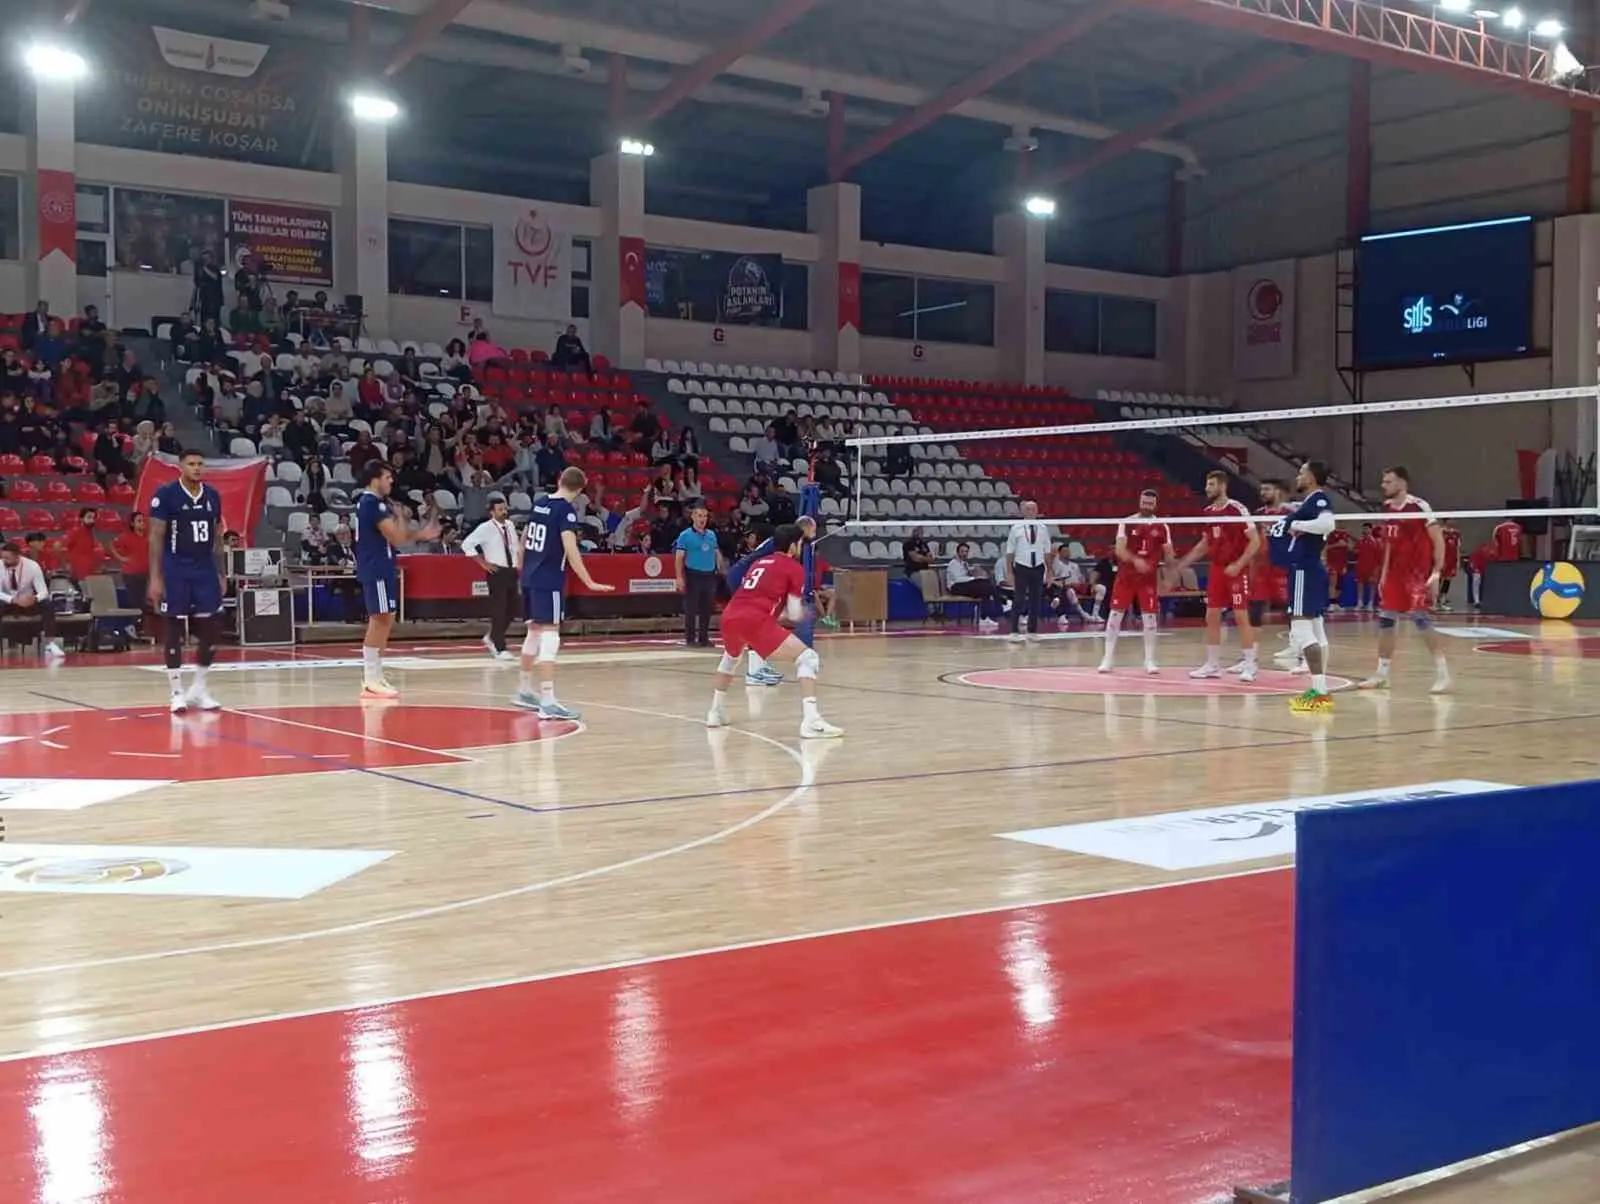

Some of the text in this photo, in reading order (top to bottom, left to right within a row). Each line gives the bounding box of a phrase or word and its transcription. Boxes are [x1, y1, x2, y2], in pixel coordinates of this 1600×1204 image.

[200, 84, 297, 113] COŞARSA
[137, 96, 266, 129] ONİKİŞUBAT
[119, 116, 281, 153] ZAFERE KOŞAR
[508, 261, 558, 288] TVF
[713, 327, 725, 342] G
[913, 344, 923, 358] G
[190, 520, 210, 543] 13
[525, 521, 548, 553] 99
[743, 567, 766, 590] 3
